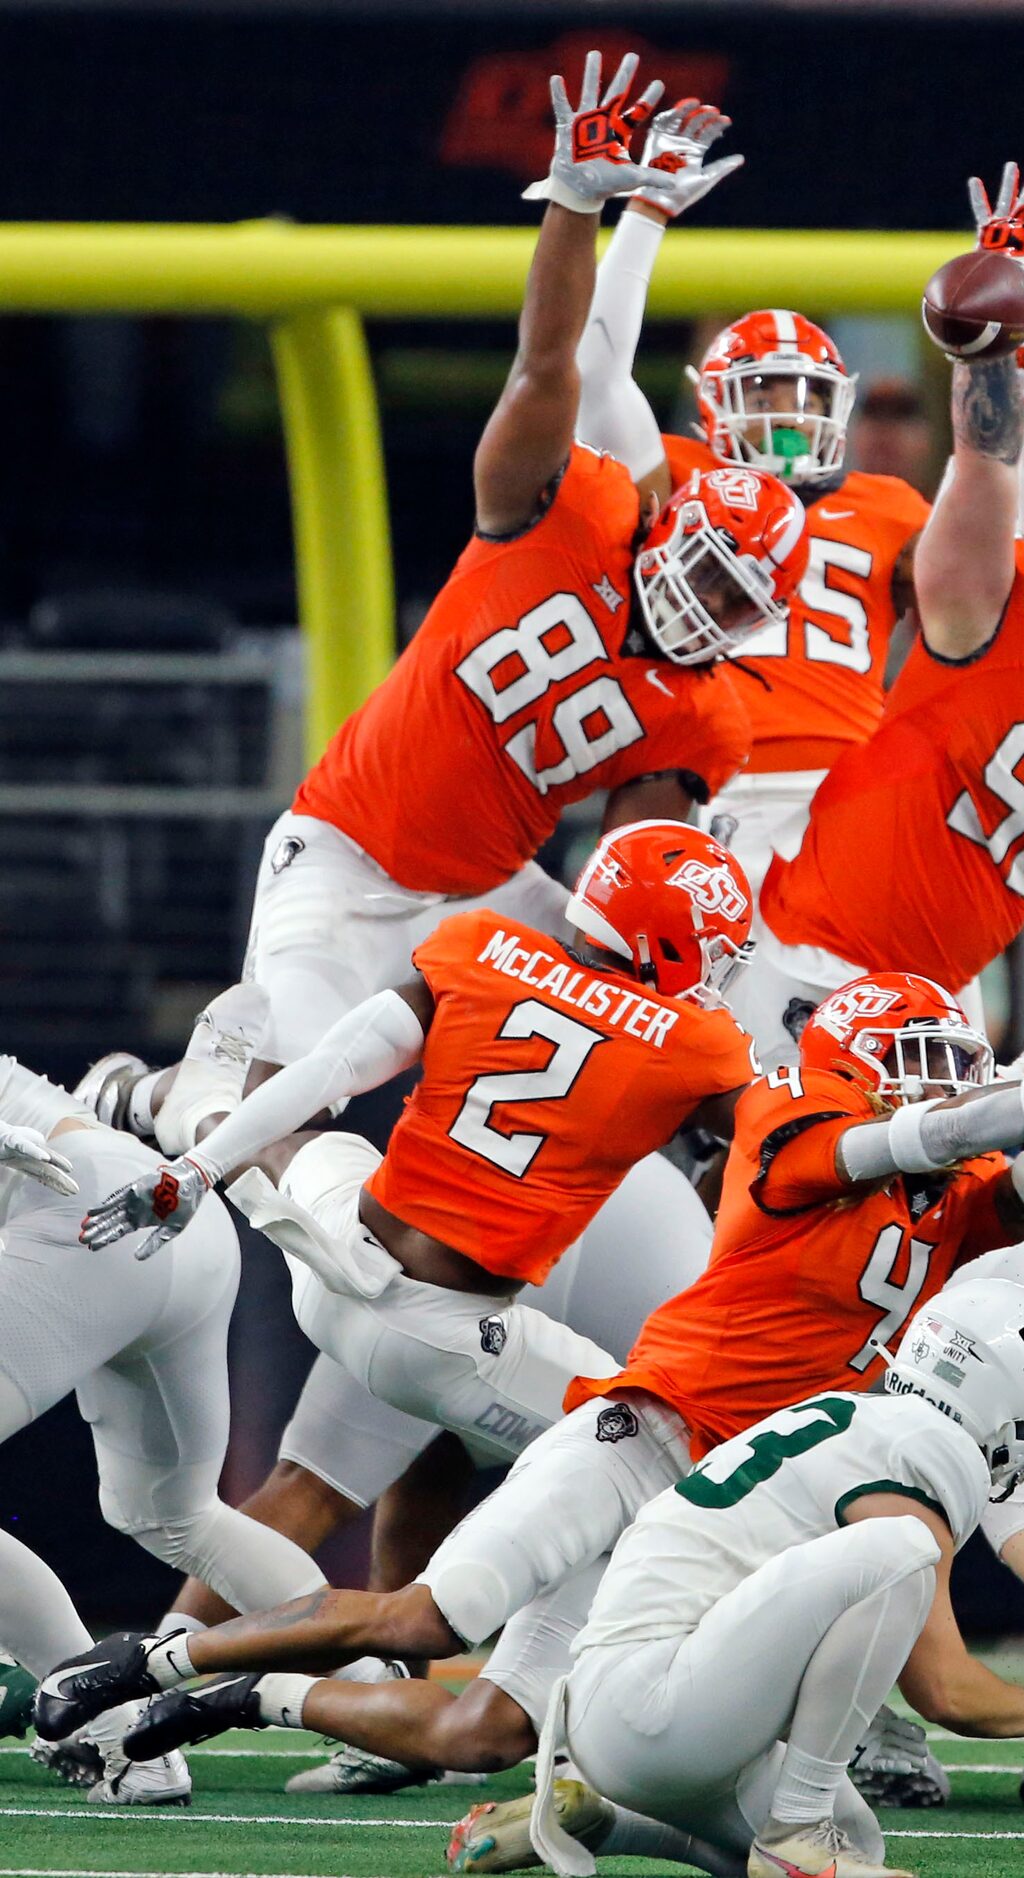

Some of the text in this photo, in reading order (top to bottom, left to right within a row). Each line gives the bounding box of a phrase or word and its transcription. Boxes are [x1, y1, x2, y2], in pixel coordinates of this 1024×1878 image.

[706, 468, 761, 511] SU
[454, 591, 647, 796] 89
[476, 930, 679, 1048] McCALISTER
[449, 998, 605, 1178] 2
[767, 1066, 804, 1098] 4
[847, 1222, 935, 1373] 4
[943, 1347, 967, 1363] UNITY
